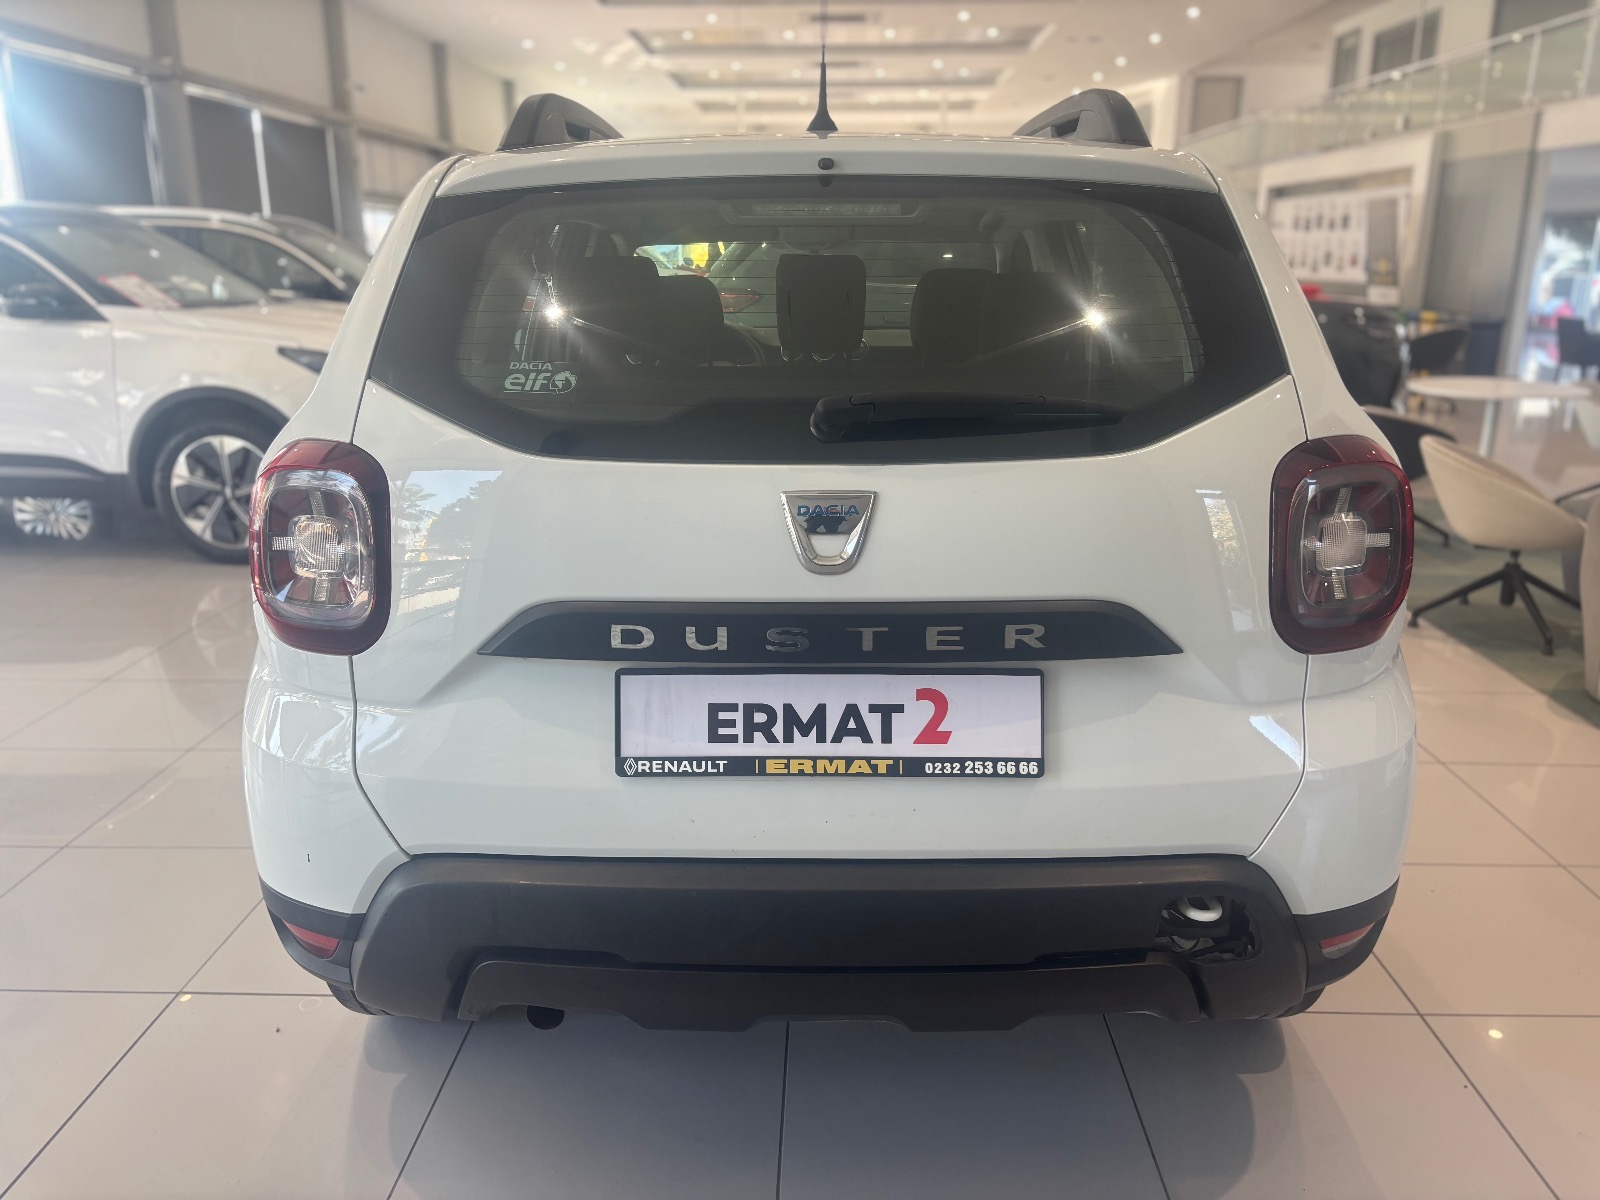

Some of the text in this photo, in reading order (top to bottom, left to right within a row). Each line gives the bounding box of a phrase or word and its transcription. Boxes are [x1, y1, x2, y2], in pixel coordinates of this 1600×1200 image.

[509, 361, 553, 370] DACIA
[504, 372, 552, 391] elf
[796, 504, 861, 517] DACIA
[610, 623, 1047, 652] DUSTER
[637, 760, 728, 773] RENAULT
[765, 759, 894, 774] ERMAT
[924, 760, 1039, 775] 0232 253 66 66
